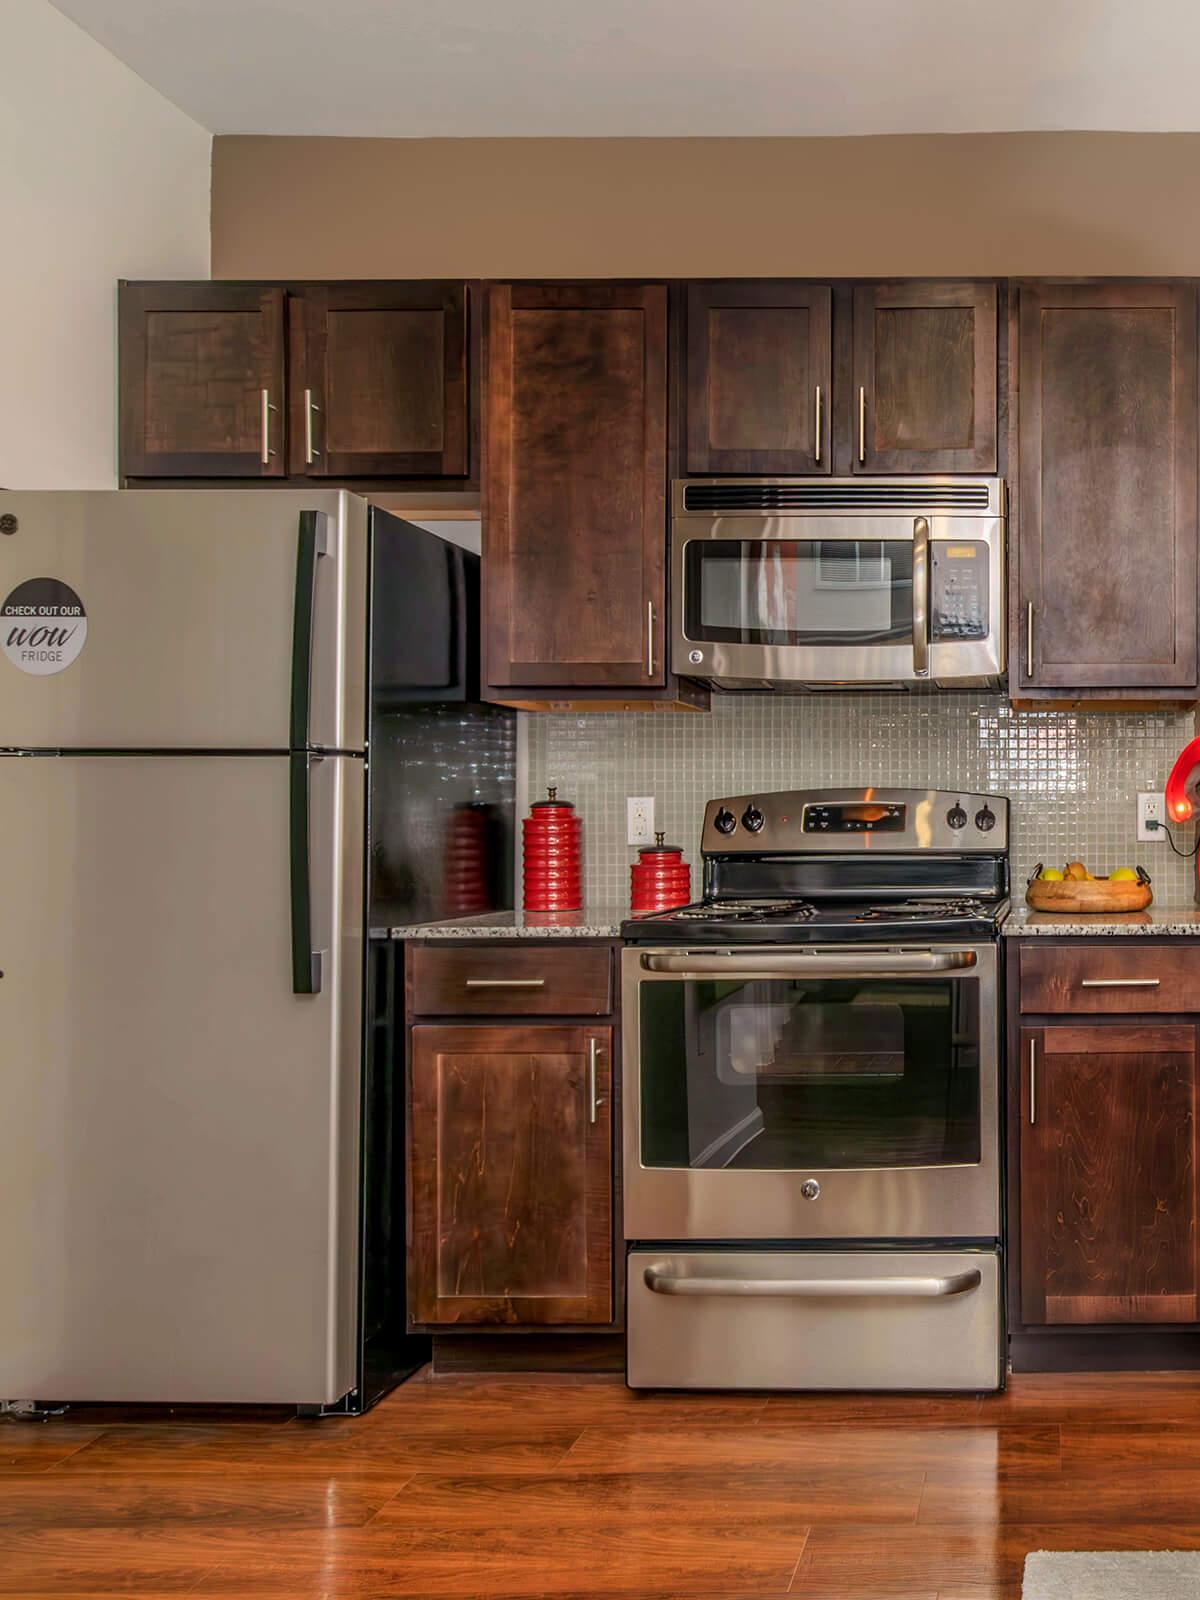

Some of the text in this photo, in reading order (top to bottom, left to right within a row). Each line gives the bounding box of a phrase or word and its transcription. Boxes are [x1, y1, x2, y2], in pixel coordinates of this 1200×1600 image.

[5, 606, 81, 616] CHECK OUT OUR
[6, 623, 78, 647] wow
[21, 650, 63, 662] FRIDGE
